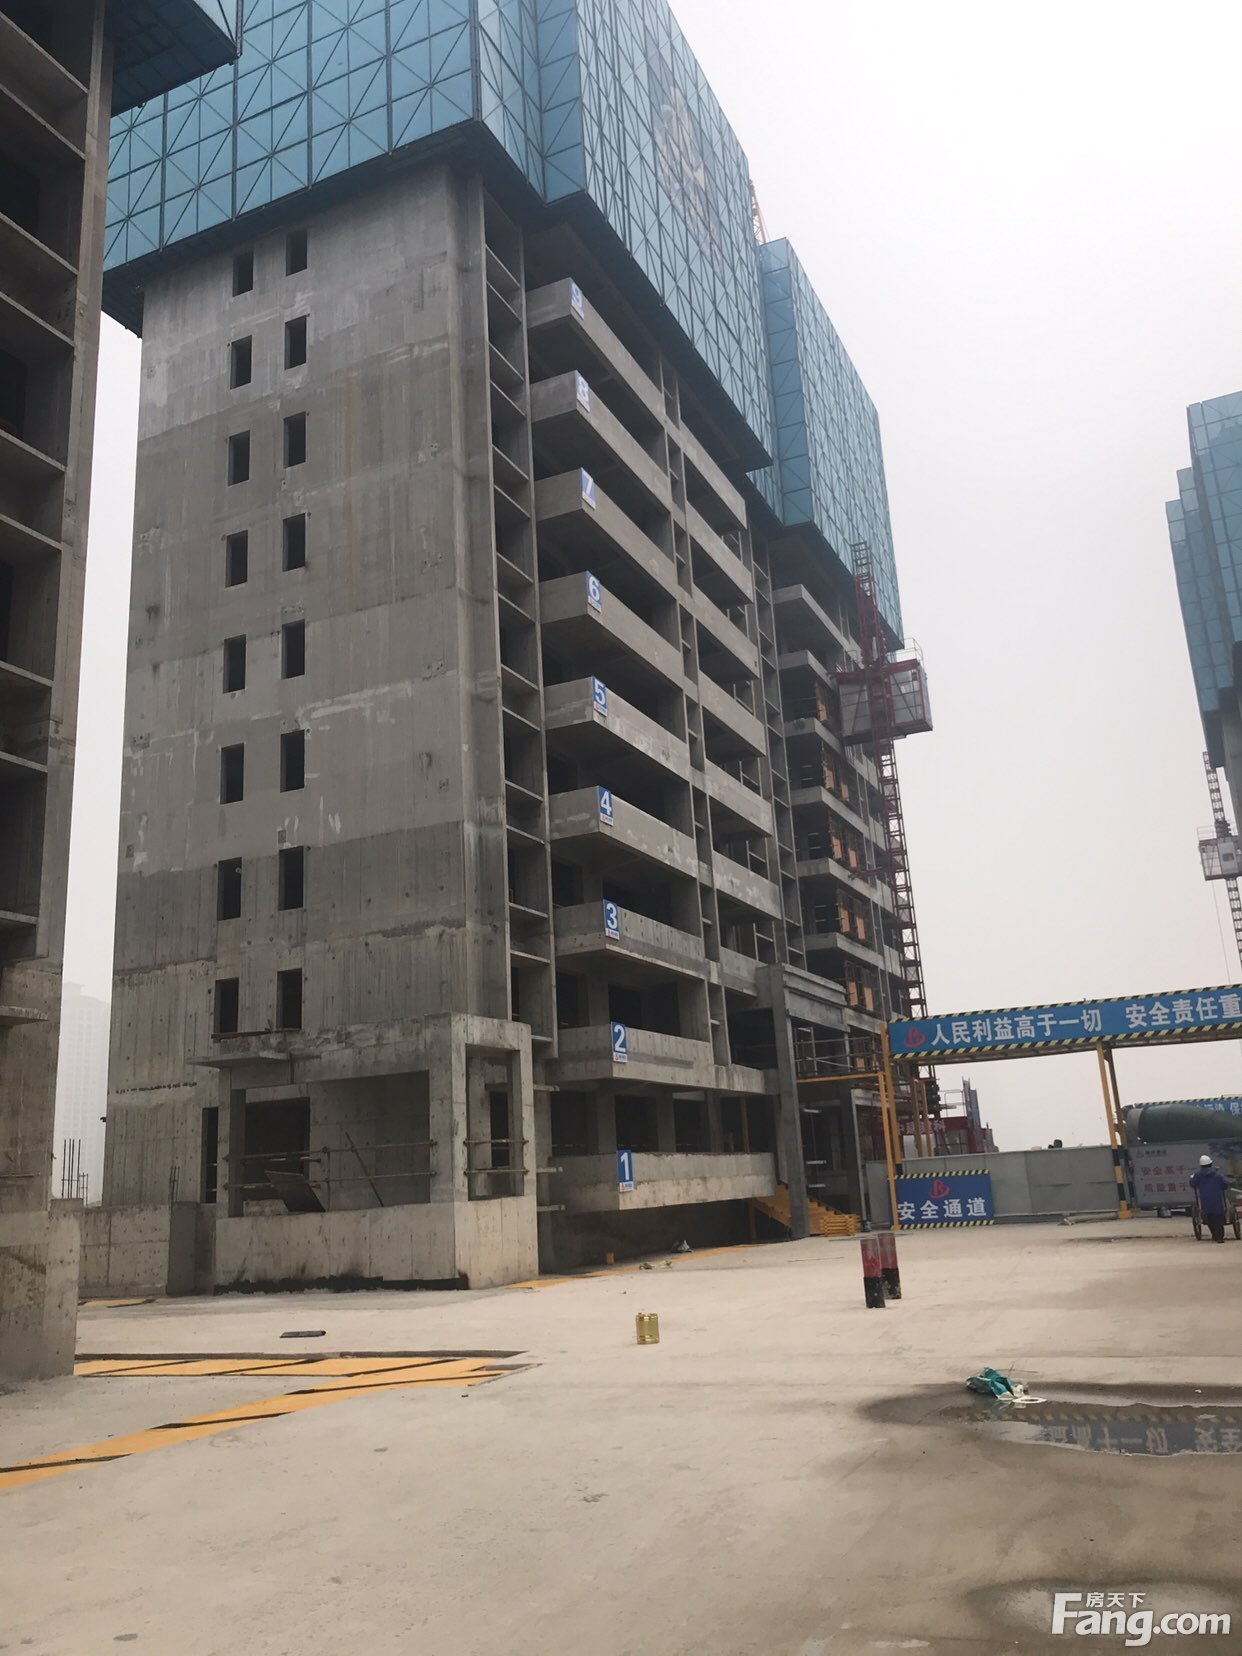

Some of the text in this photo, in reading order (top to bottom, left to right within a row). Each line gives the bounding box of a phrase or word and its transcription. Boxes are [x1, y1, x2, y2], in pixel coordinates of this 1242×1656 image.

[577, 375, 589, 401] 8
[581, 468, 594, 496] 7
[588, 575, 601, 602] 6
[594, 680, 606, 706] 5
[600, 790, 612, 816] 4
[606, 902, 618, 929] 3
[929, 993, 1242, 1046] 人民利益高于一切 安全责任重
[614, 1024, 626, 1053] 2
[620, 1151, 630, 1181] 1
[896, 1197, 987, 1221] 安全通道
